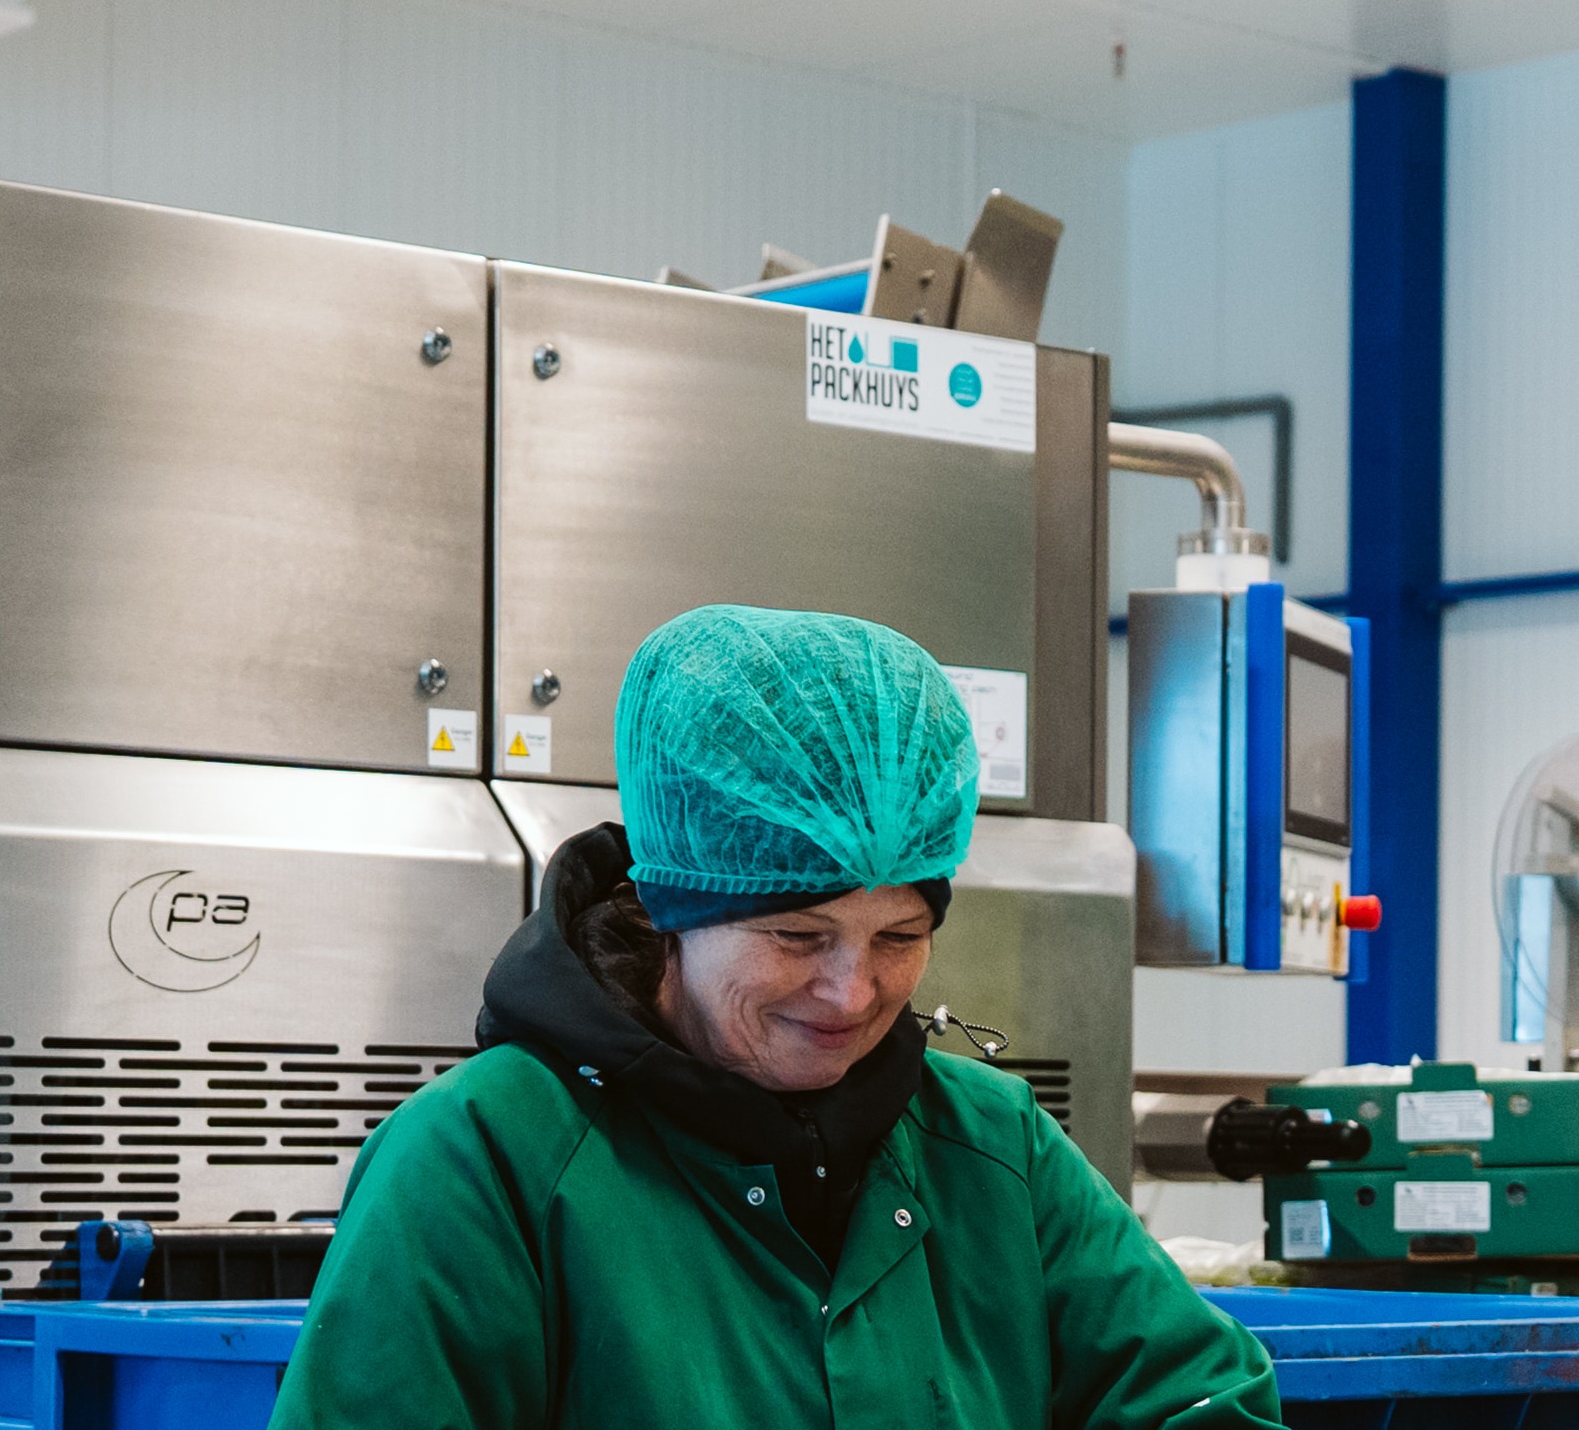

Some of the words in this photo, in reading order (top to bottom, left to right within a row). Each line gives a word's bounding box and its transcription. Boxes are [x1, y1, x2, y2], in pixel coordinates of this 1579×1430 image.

[811, 324, 846, 362] HET
[811, 362, 919, 412] PACKHUYS
[167, 892, 250, 932] pa
